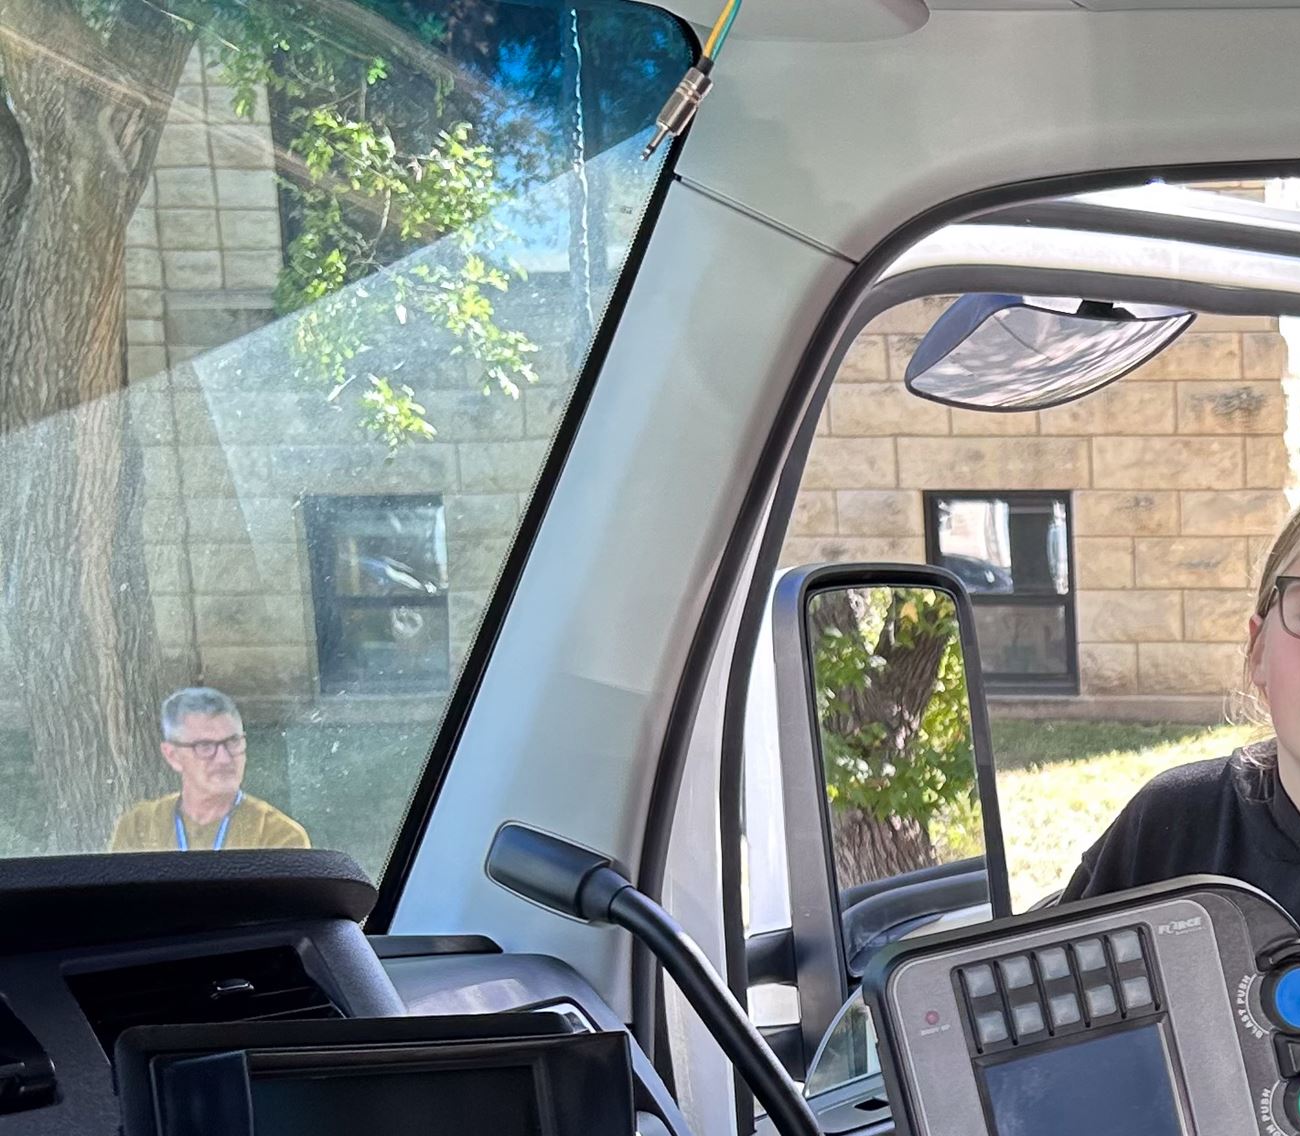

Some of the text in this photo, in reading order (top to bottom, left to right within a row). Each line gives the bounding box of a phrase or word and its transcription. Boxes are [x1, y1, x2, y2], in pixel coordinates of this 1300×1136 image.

[1236, 974, 1264, 1039] BLAST PUSH
[1260, 1088, 1271, 1122] PUSH
